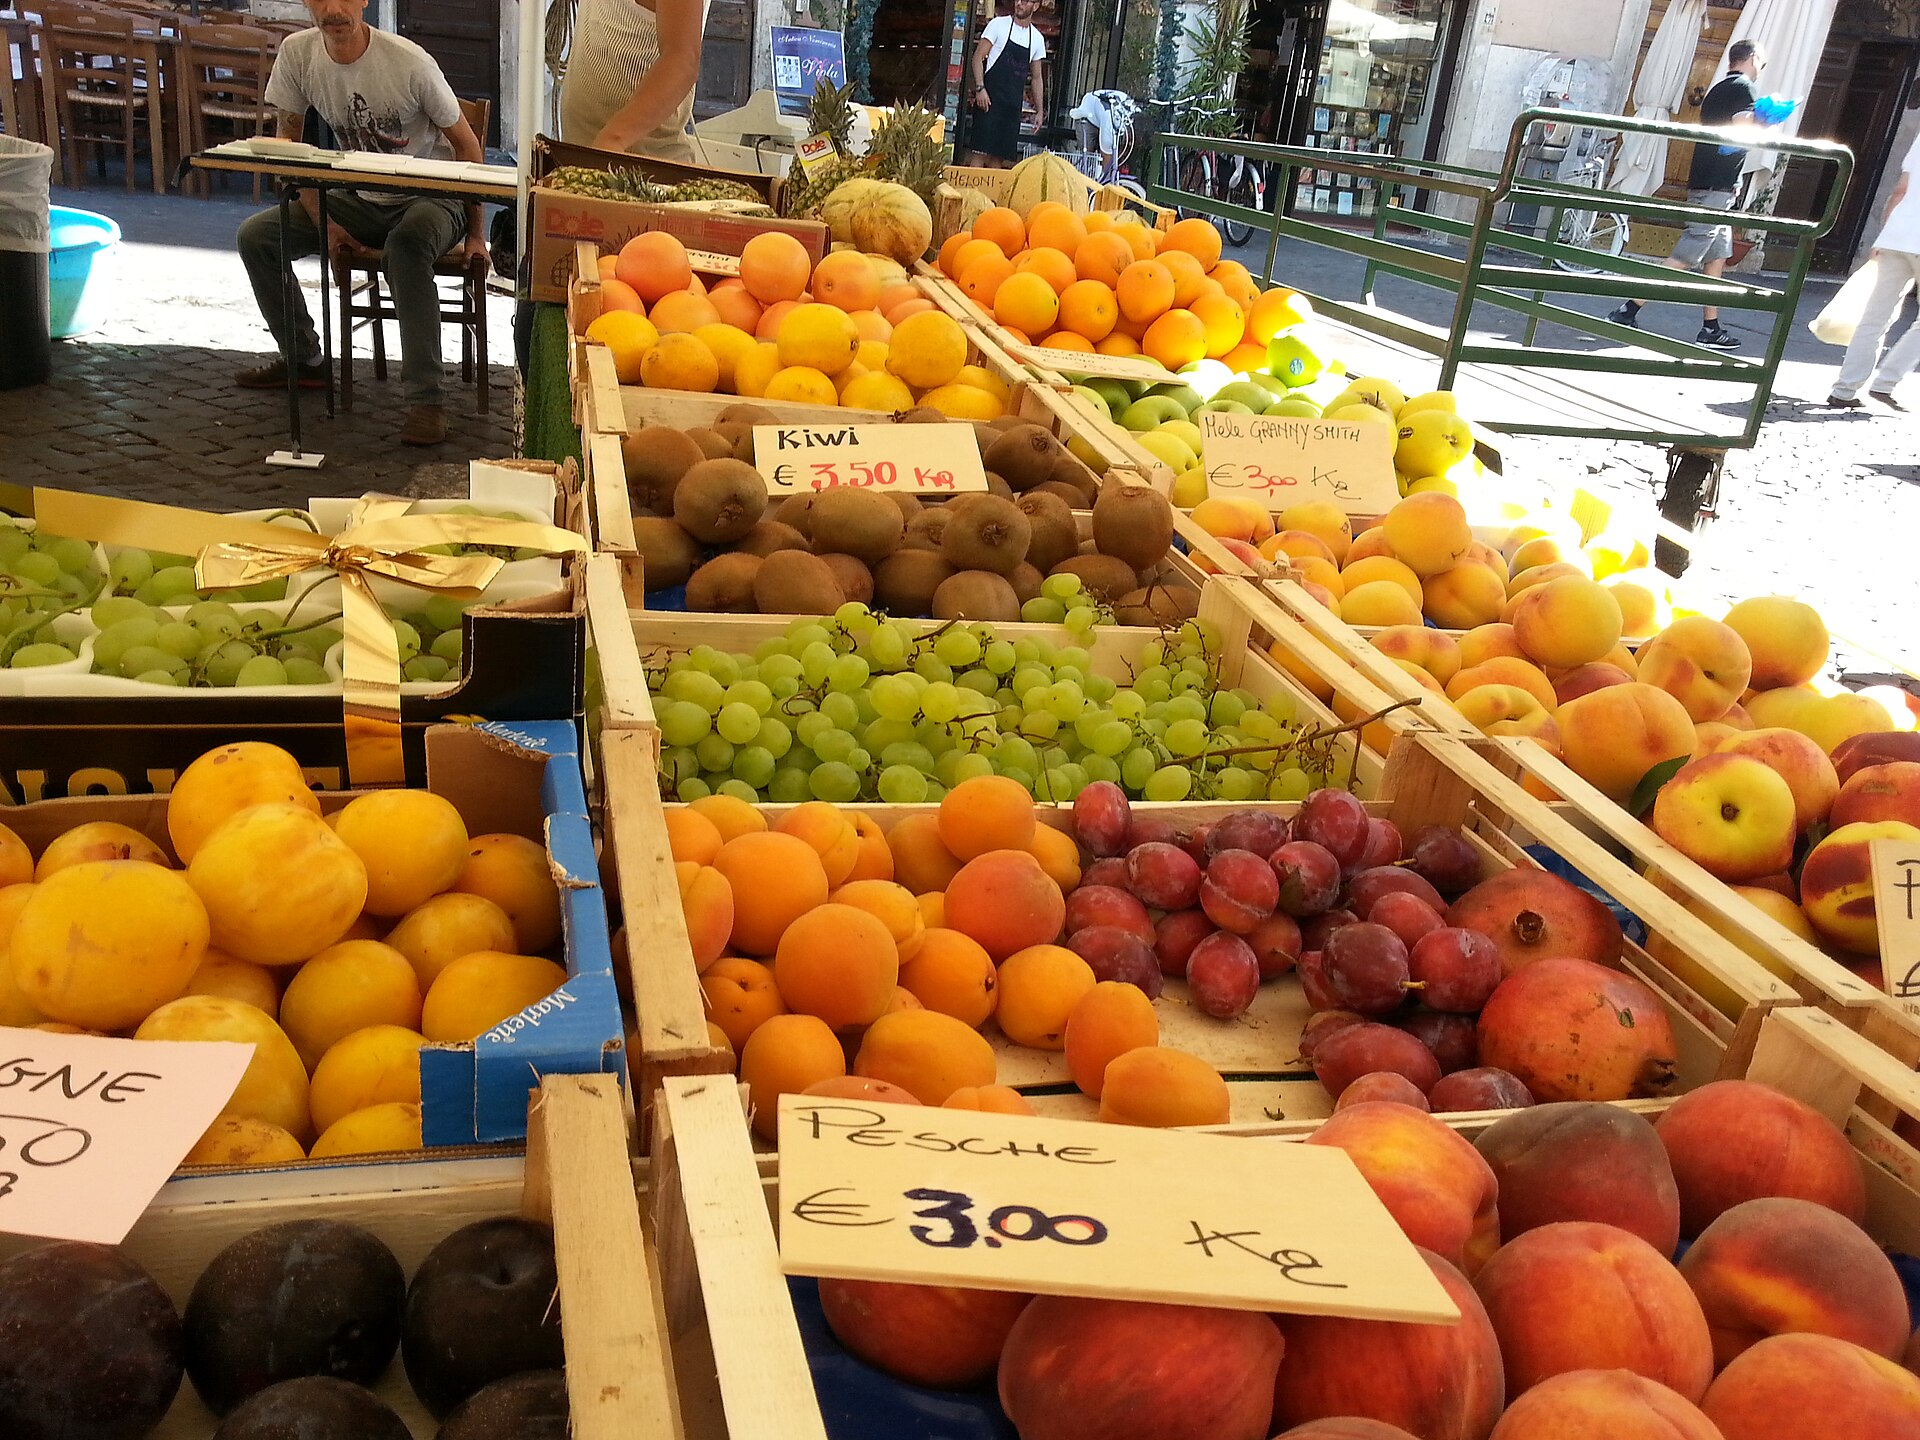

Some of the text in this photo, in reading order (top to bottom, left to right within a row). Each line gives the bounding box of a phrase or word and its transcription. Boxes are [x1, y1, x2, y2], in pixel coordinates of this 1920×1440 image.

[802, 59, 839, 78] Viola
[801, 140, 826, 154] Dole
[545, 208, 604, 237] Dole
[1205, 414, 1244, 438] Mele
[1250, 420, 1309, 450] GRANNY
[773, 464, 797, 486] €
[486, 988, 577, 1043] Marlene
[793, 1106, 1116, 1164] PESCHE
[791, 1187, 895, 1226] €
[903, 1187, 1109, 1249] 3.00
